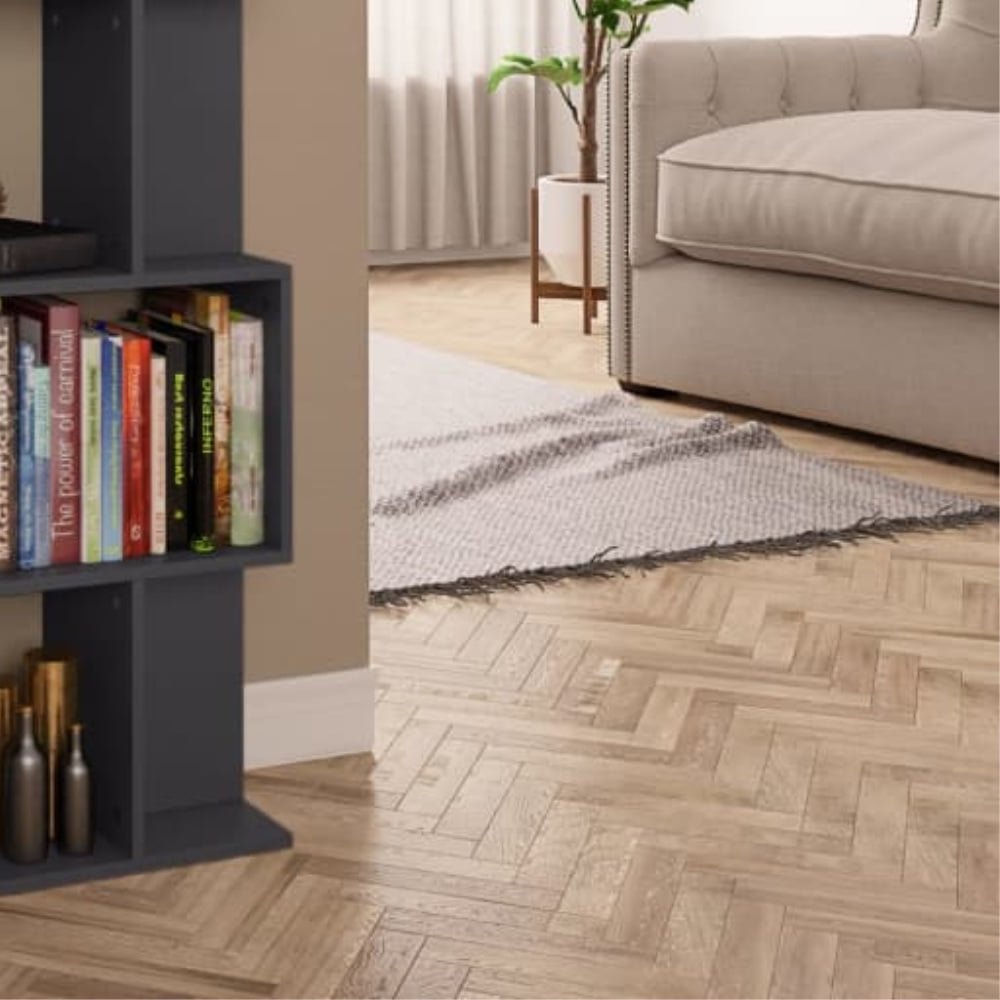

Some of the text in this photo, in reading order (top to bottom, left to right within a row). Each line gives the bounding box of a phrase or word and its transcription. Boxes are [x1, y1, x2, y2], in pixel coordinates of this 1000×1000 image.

[53, 328, 79, 540] The power of carnival
[201, 377, 214, 454] INFERNO
